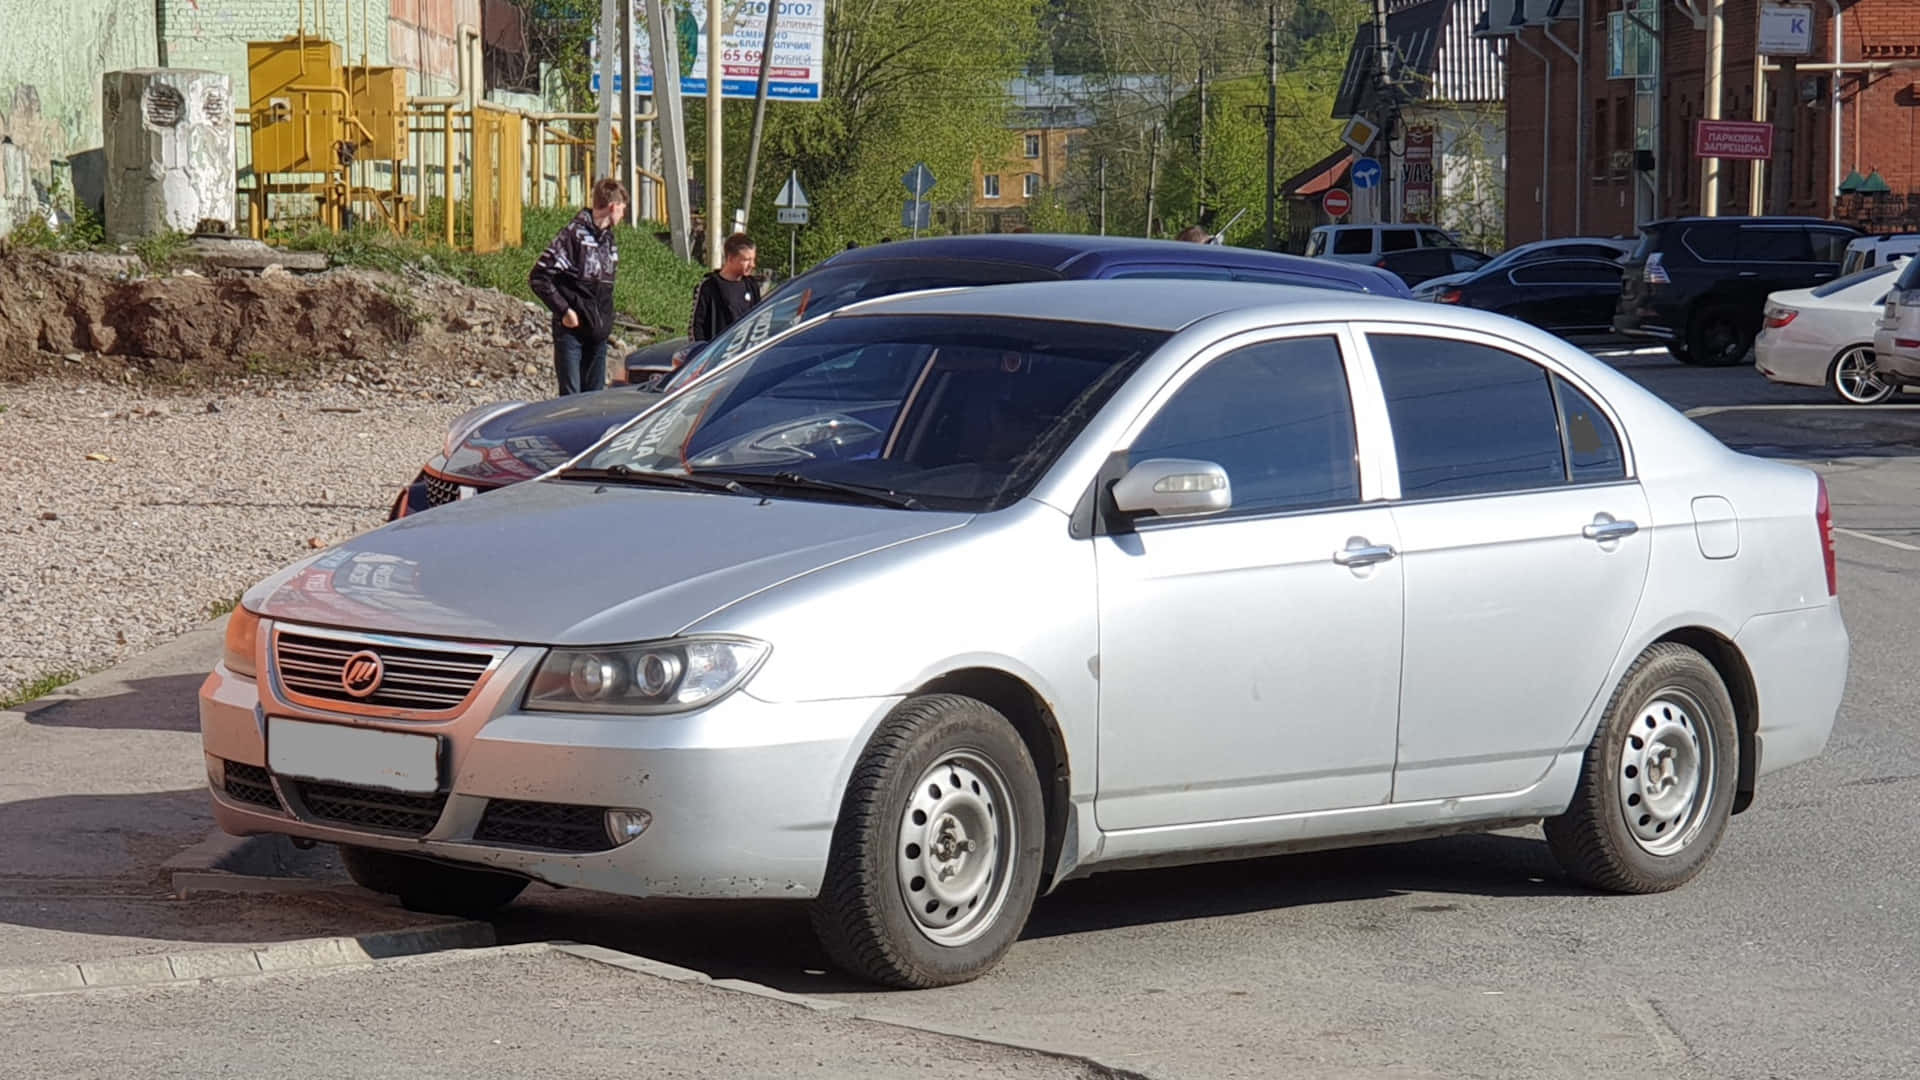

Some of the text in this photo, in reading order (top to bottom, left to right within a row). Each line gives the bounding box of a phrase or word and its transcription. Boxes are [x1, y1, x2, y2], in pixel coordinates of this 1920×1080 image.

[739, 1, 813, 16] ТООГО?
[1708, 132, 1761, 143] ПАРКОВКА
[1703, 142, 1765, 153] ЗАПРЕЩЕНА
